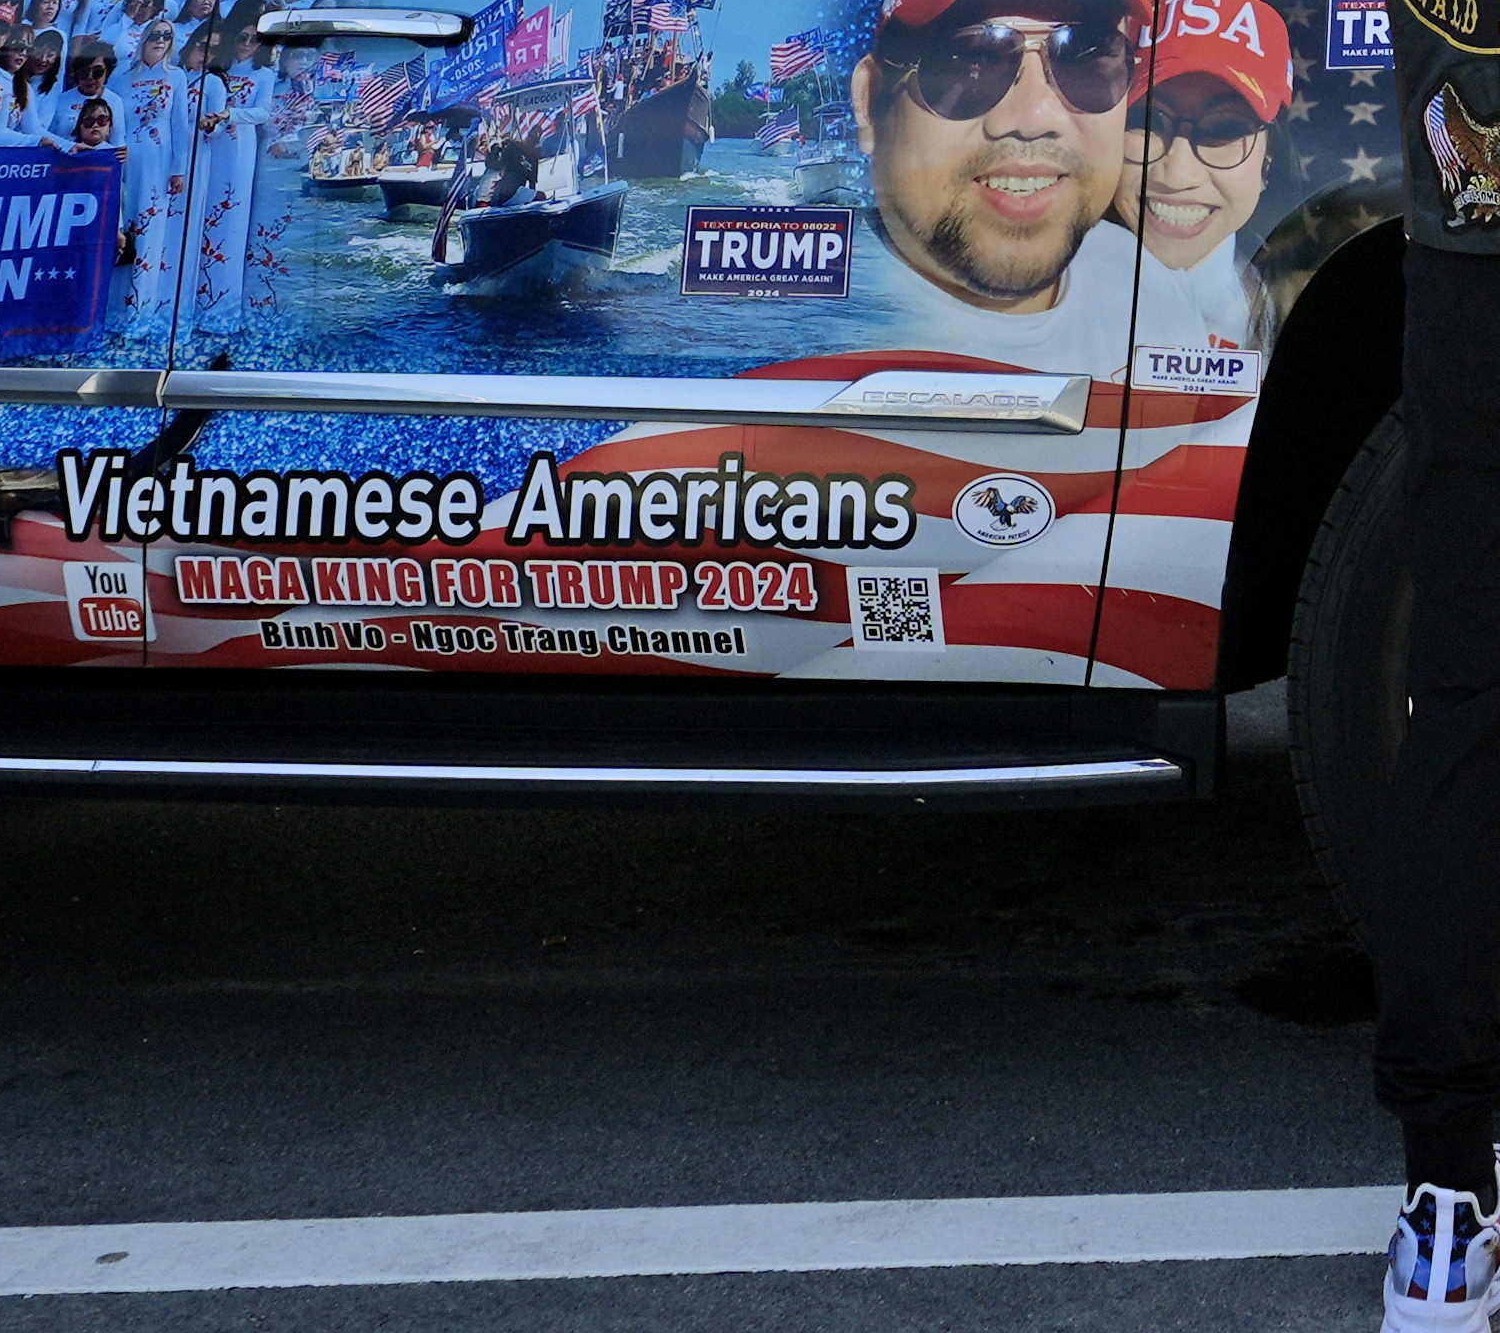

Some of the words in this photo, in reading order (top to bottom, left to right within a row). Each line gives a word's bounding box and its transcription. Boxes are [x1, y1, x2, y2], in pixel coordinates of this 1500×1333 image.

[1343, 48, 1368, 56] MAKE
[702, 221, 732, 229] TEXT
[735, 221, 781, 230] FLORIA
[783, 222, 799, 230] TO
[695, 231, 843, 270] TRUMP
[699, 273, 725, 282] MAKE
[726, 273, 767, 282] AMERICA
[769, 274, 799, 283] GREAT
[747, 289, 780, 298] 2024
[1149, 354, 1243, 377] TRUMP
[863, 391, 1039, 408] ESCALADE
[62, 455, 477, 539] Vietnamese
[512, 458, 910, 542] Americans
[84, 566, 128, 595] You
[175, 556, 309, 606] MAGA
[312, 558, 423, 607] KING
[432, 559, 521, 608] FOR
[529, 560, 688, 609] TRUMP
[697, 562, 817, 612] 2024
[83, 603, 142, 631] Tube
[260, 621, 338, 650] Binh
[343, 622, 387, 652] Vo
[409, 622, 497, 655] Ngoc
[500, 622, 601, 656] Trang
[606, 625, 746, 656] Channel
